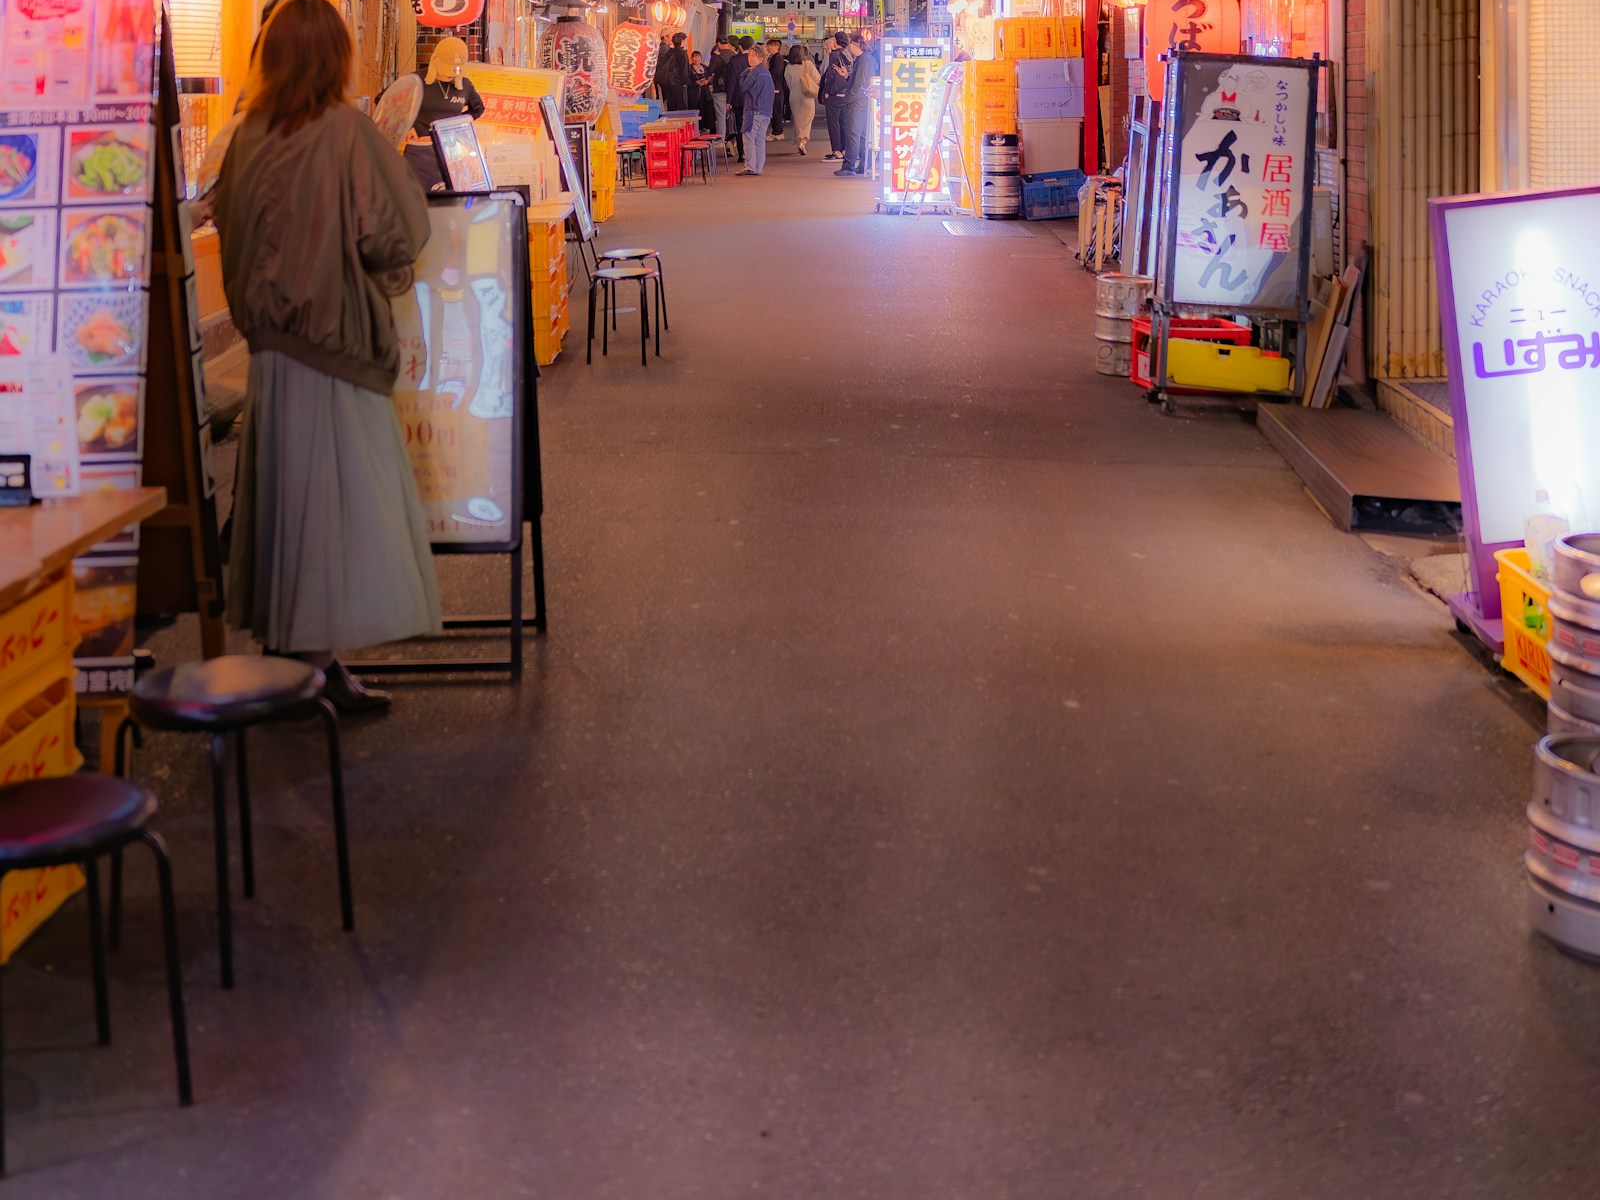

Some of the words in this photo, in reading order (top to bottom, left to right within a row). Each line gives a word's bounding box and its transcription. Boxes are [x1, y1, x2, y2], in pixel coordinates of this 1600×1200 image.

[502, 100, 538, 113] 新橋店
[1272, 79, 1289, 147] なつかしい味
[1258, 153, 1293, 253] 居酒屋
[1516, 628, 1550, 675] KIRIN
